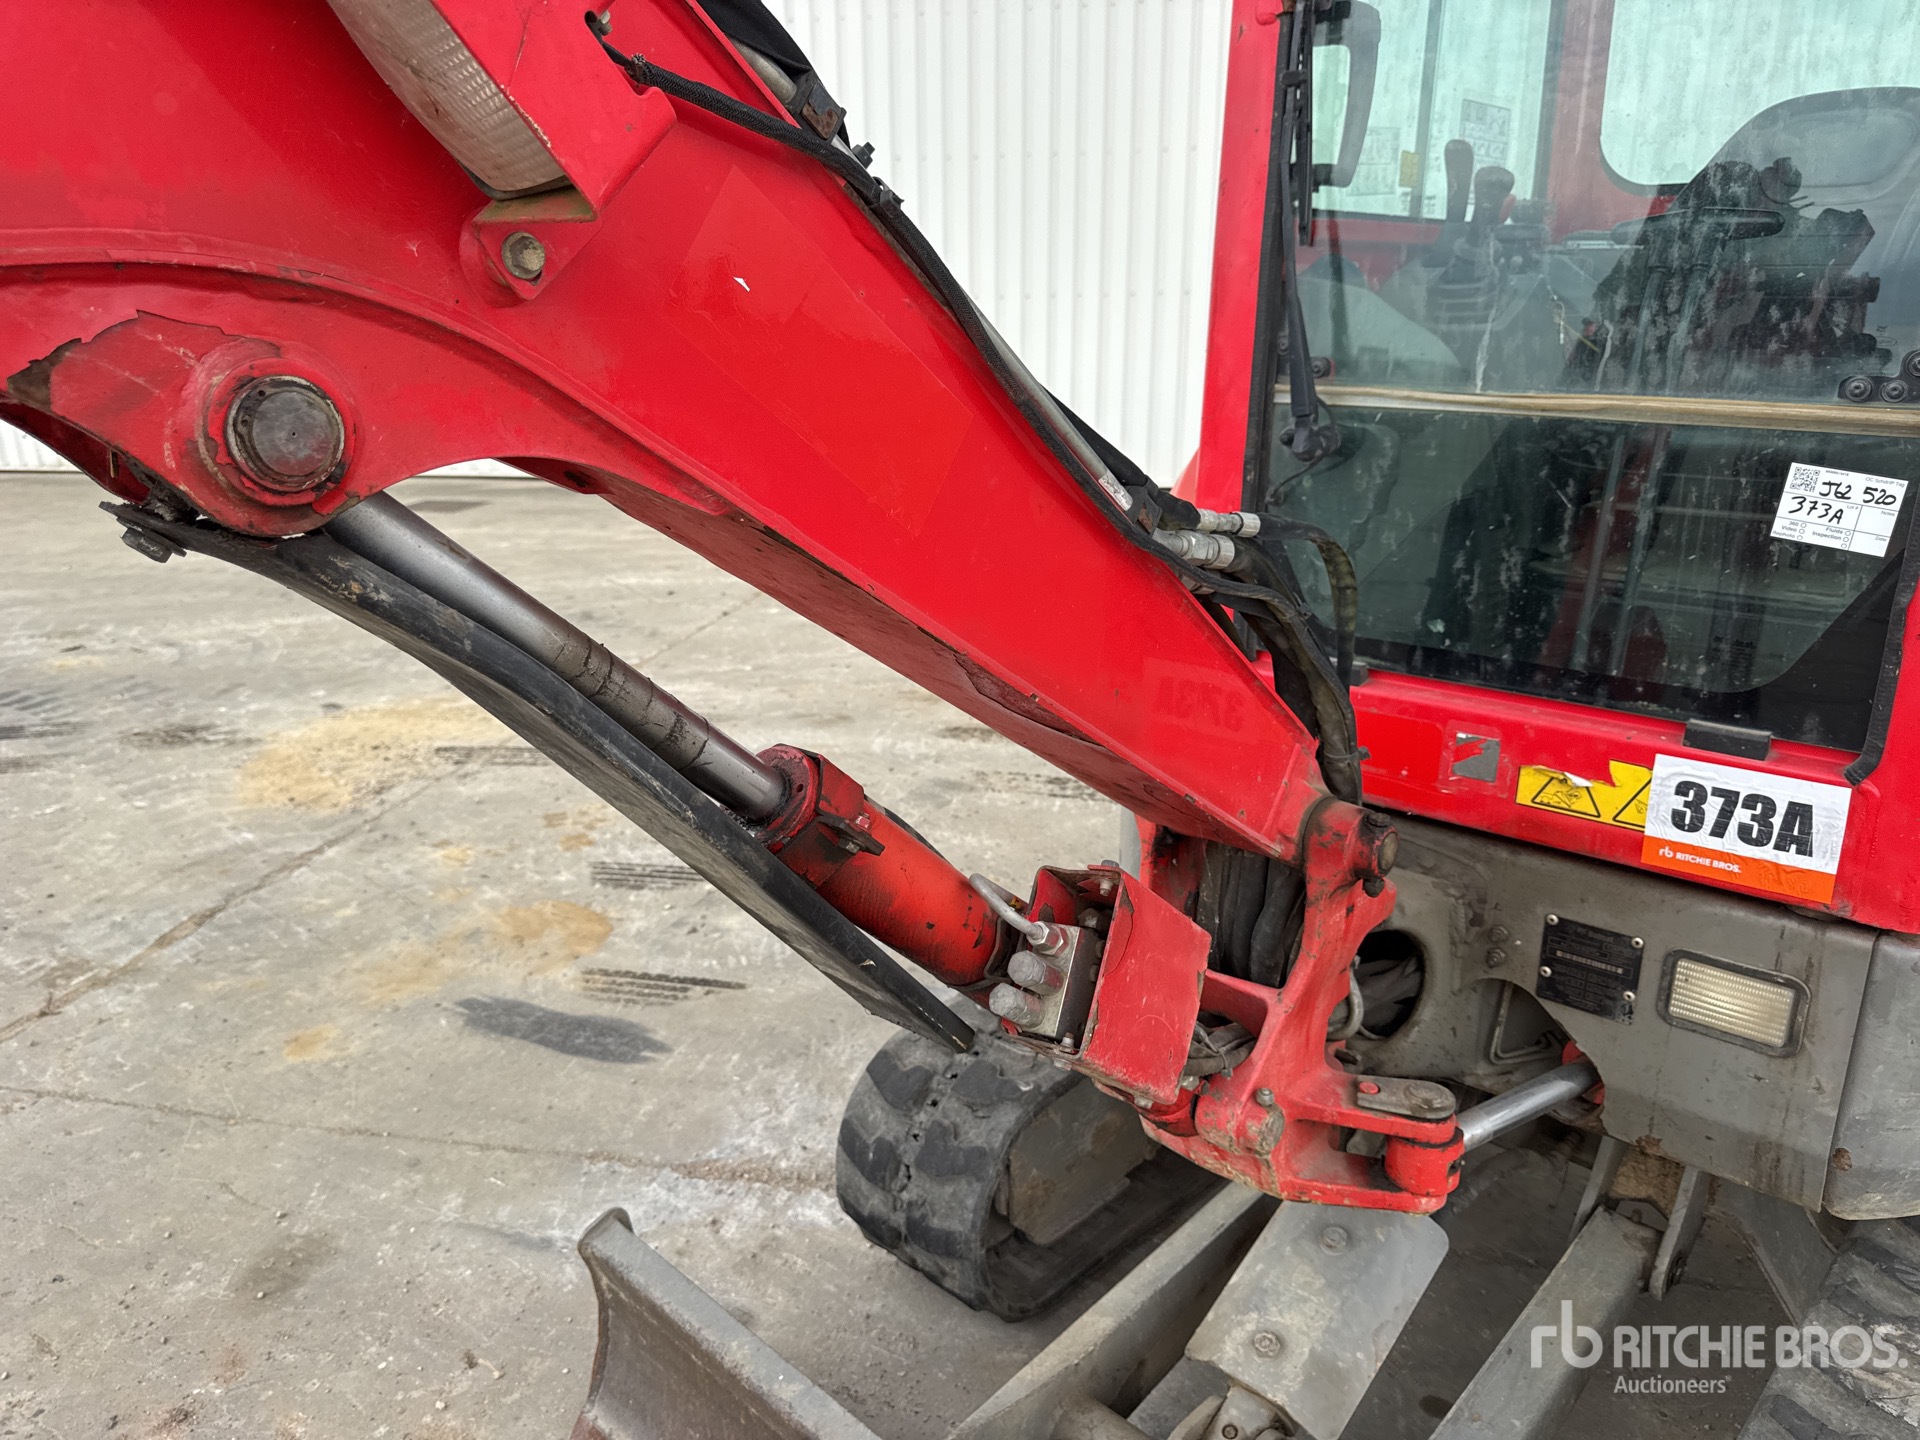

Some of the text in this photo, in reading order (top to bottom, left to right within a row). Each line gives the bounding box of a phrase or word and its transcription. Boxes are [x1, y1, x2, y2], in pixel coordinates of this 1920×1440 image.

[1862, 486, 1896, 505] 520
[1788, 496, 1843, 524] 373A
[1812, 531, 1842, 540] Inspection
[1671, 780, 1813, 857] 373A
[1658, 845, 1742, 873] rb RITCHIE BROS.
